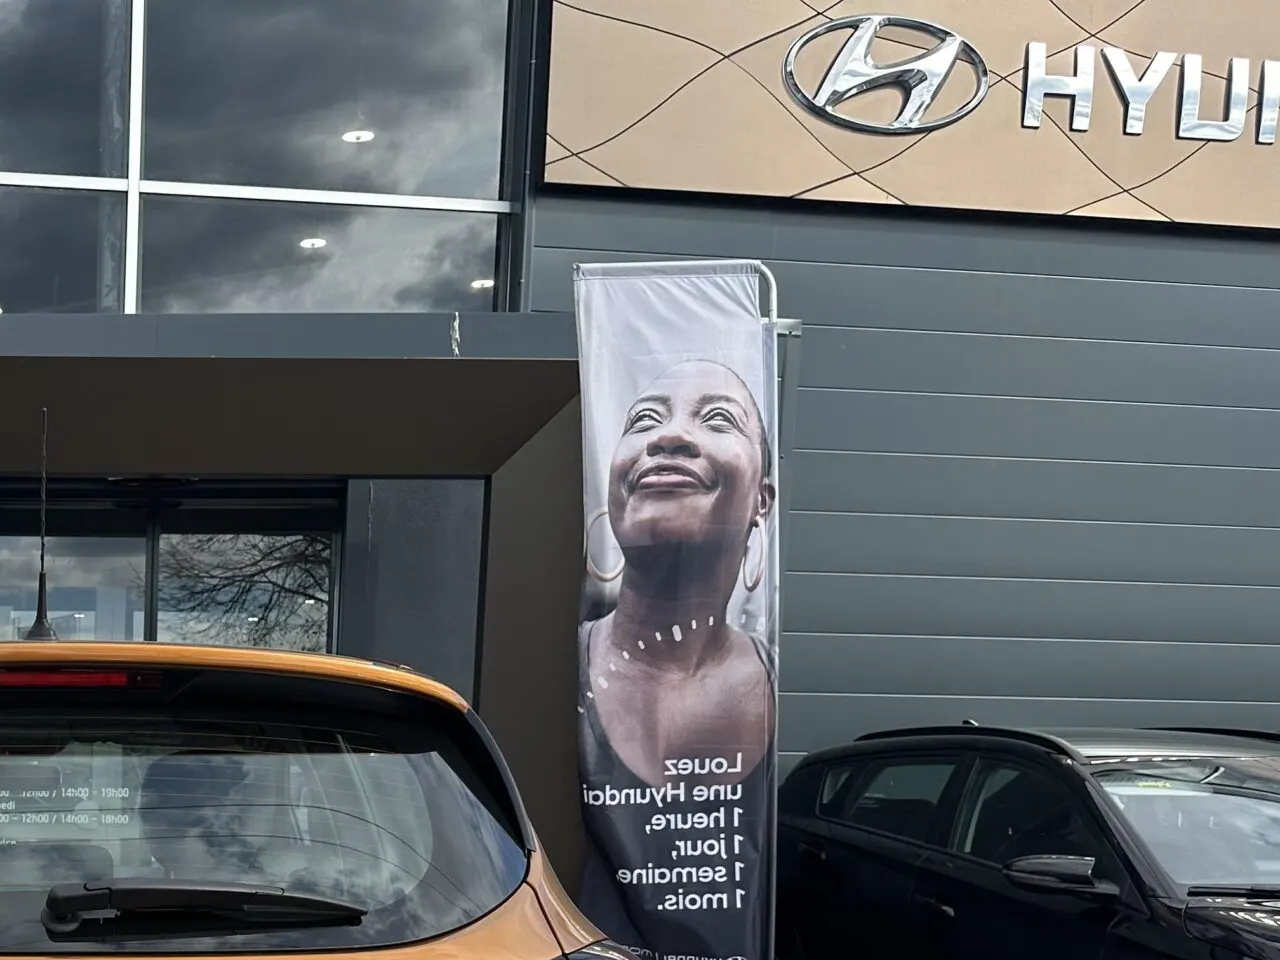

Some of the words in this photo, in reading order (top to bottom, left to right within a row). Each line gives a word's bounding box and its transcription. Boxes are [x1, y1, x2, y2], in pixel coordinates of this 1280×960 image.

[61, 787, 89, 798] 14h00
[101, 787, 130, 798] 19h00
[21, 813, 50, 824] 12h00
[61, 814, 89, 824] 14h00
[101, 814, 129, 824] 18h00
